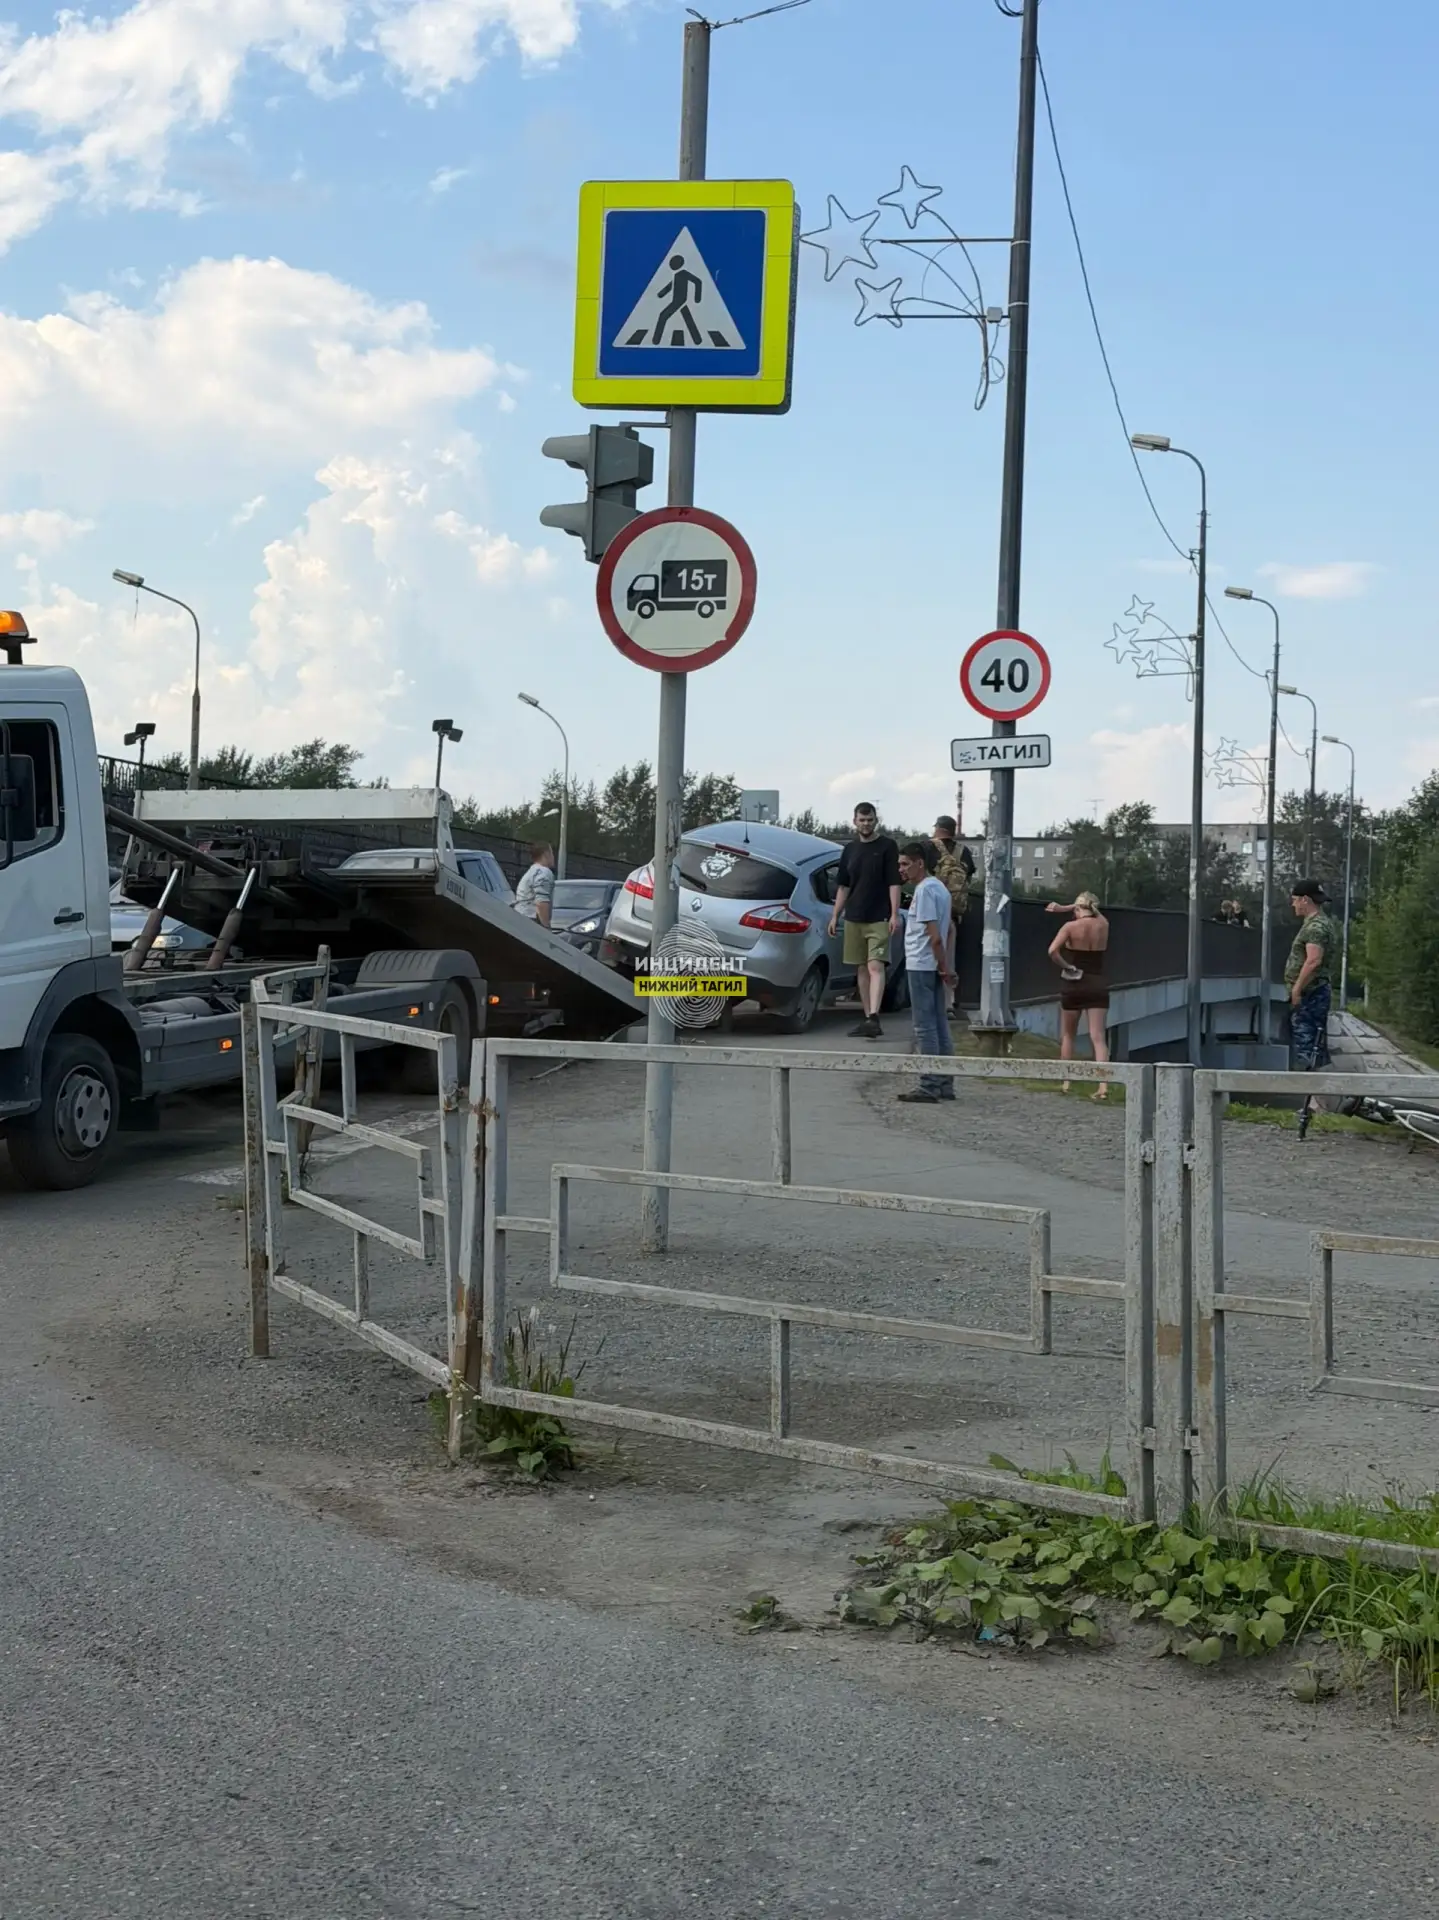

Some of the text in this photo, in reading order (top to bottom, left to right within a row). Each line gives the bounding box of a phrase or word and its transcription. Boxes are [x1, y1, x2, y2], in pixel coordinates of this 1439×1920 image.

[677, 568, 718, 591] 15т
[980, 658, 1030, 693] 40
[976, 744, 1042, 760] ТАГИЛ
